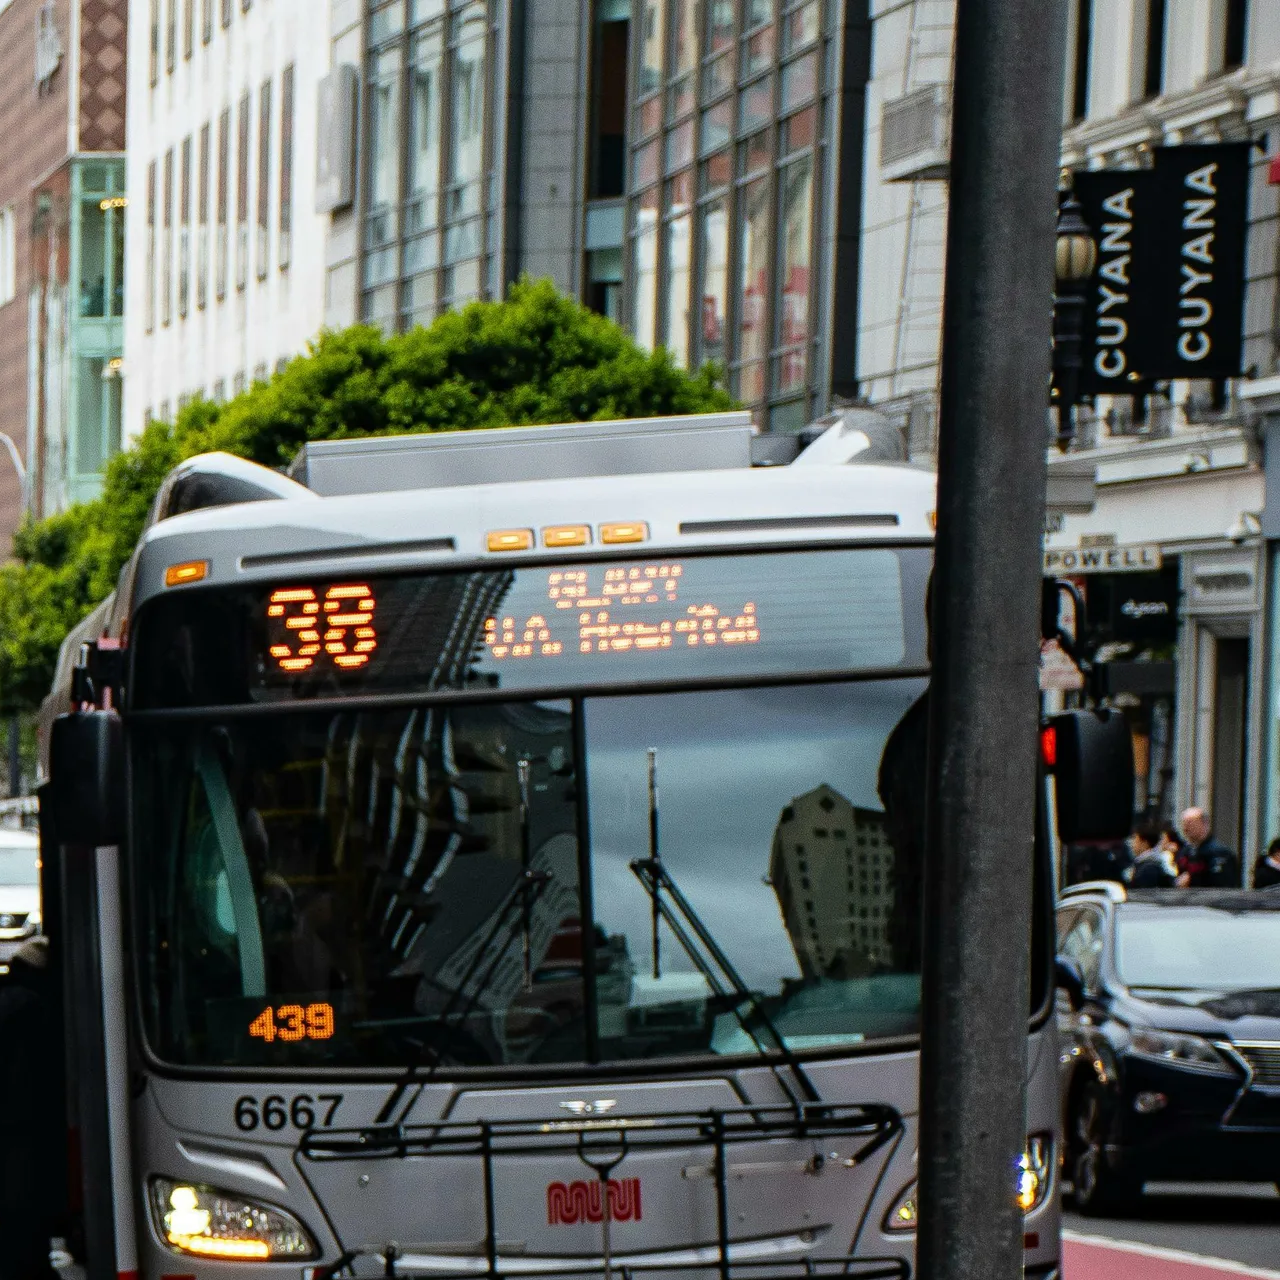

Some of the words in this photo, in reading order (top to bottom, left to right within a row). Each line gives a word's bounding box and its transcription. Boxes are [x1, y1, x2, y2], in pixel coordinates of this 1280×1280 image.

[1094, 188, 1134, 378] CUYANA
[1176, 162, 1218, 362] CUYANA
[1044, 550, 1150, 569] POWELL
[268, 583, 377, 673] 38
[248, 1003, 334, 1042] 439
[234, 1093, 344, 1131] 6667
